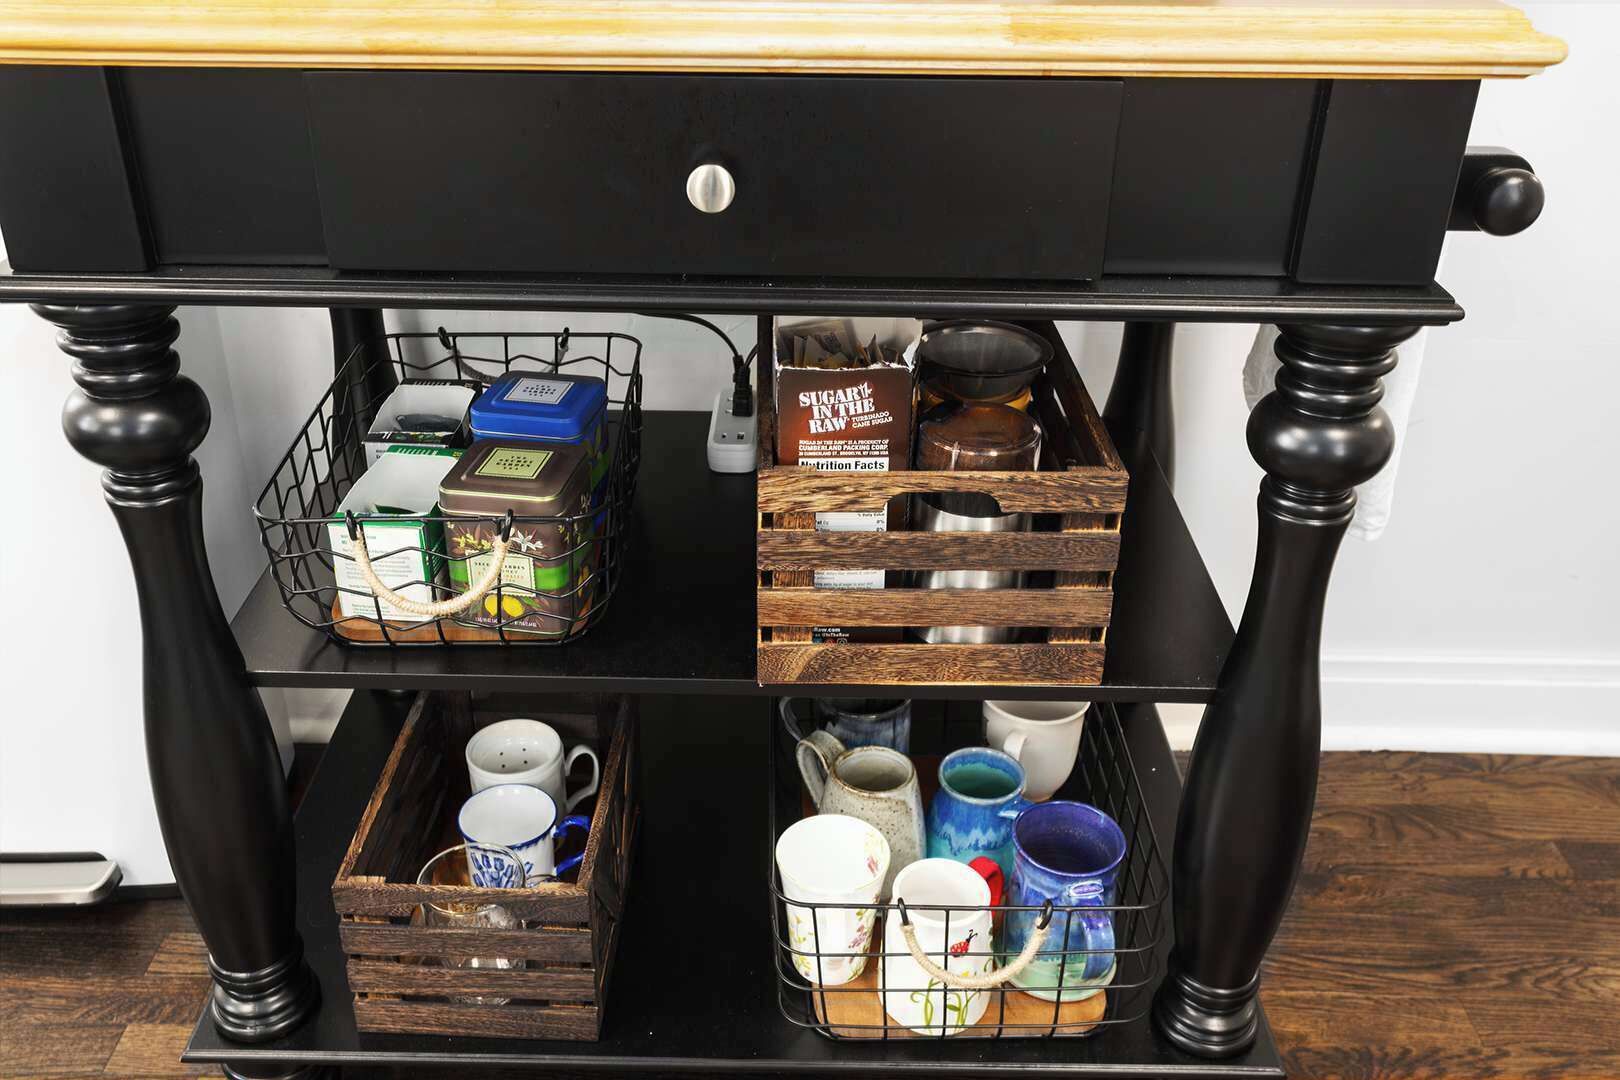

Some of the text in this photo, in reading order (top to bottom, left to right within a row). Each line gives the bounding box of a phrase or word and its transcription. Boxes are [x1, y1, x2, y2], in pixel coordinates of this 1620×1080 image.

[799, 386, 862, 407] SUGAR
[812, 398, 875, 420] IN THE
[851, 411, 890, 423] TURBINADO
[852, 416, 893, 429] CANE SUGAR
[808, 416, 847, 434] RAW
[855, 461, 885, 470] Facts
